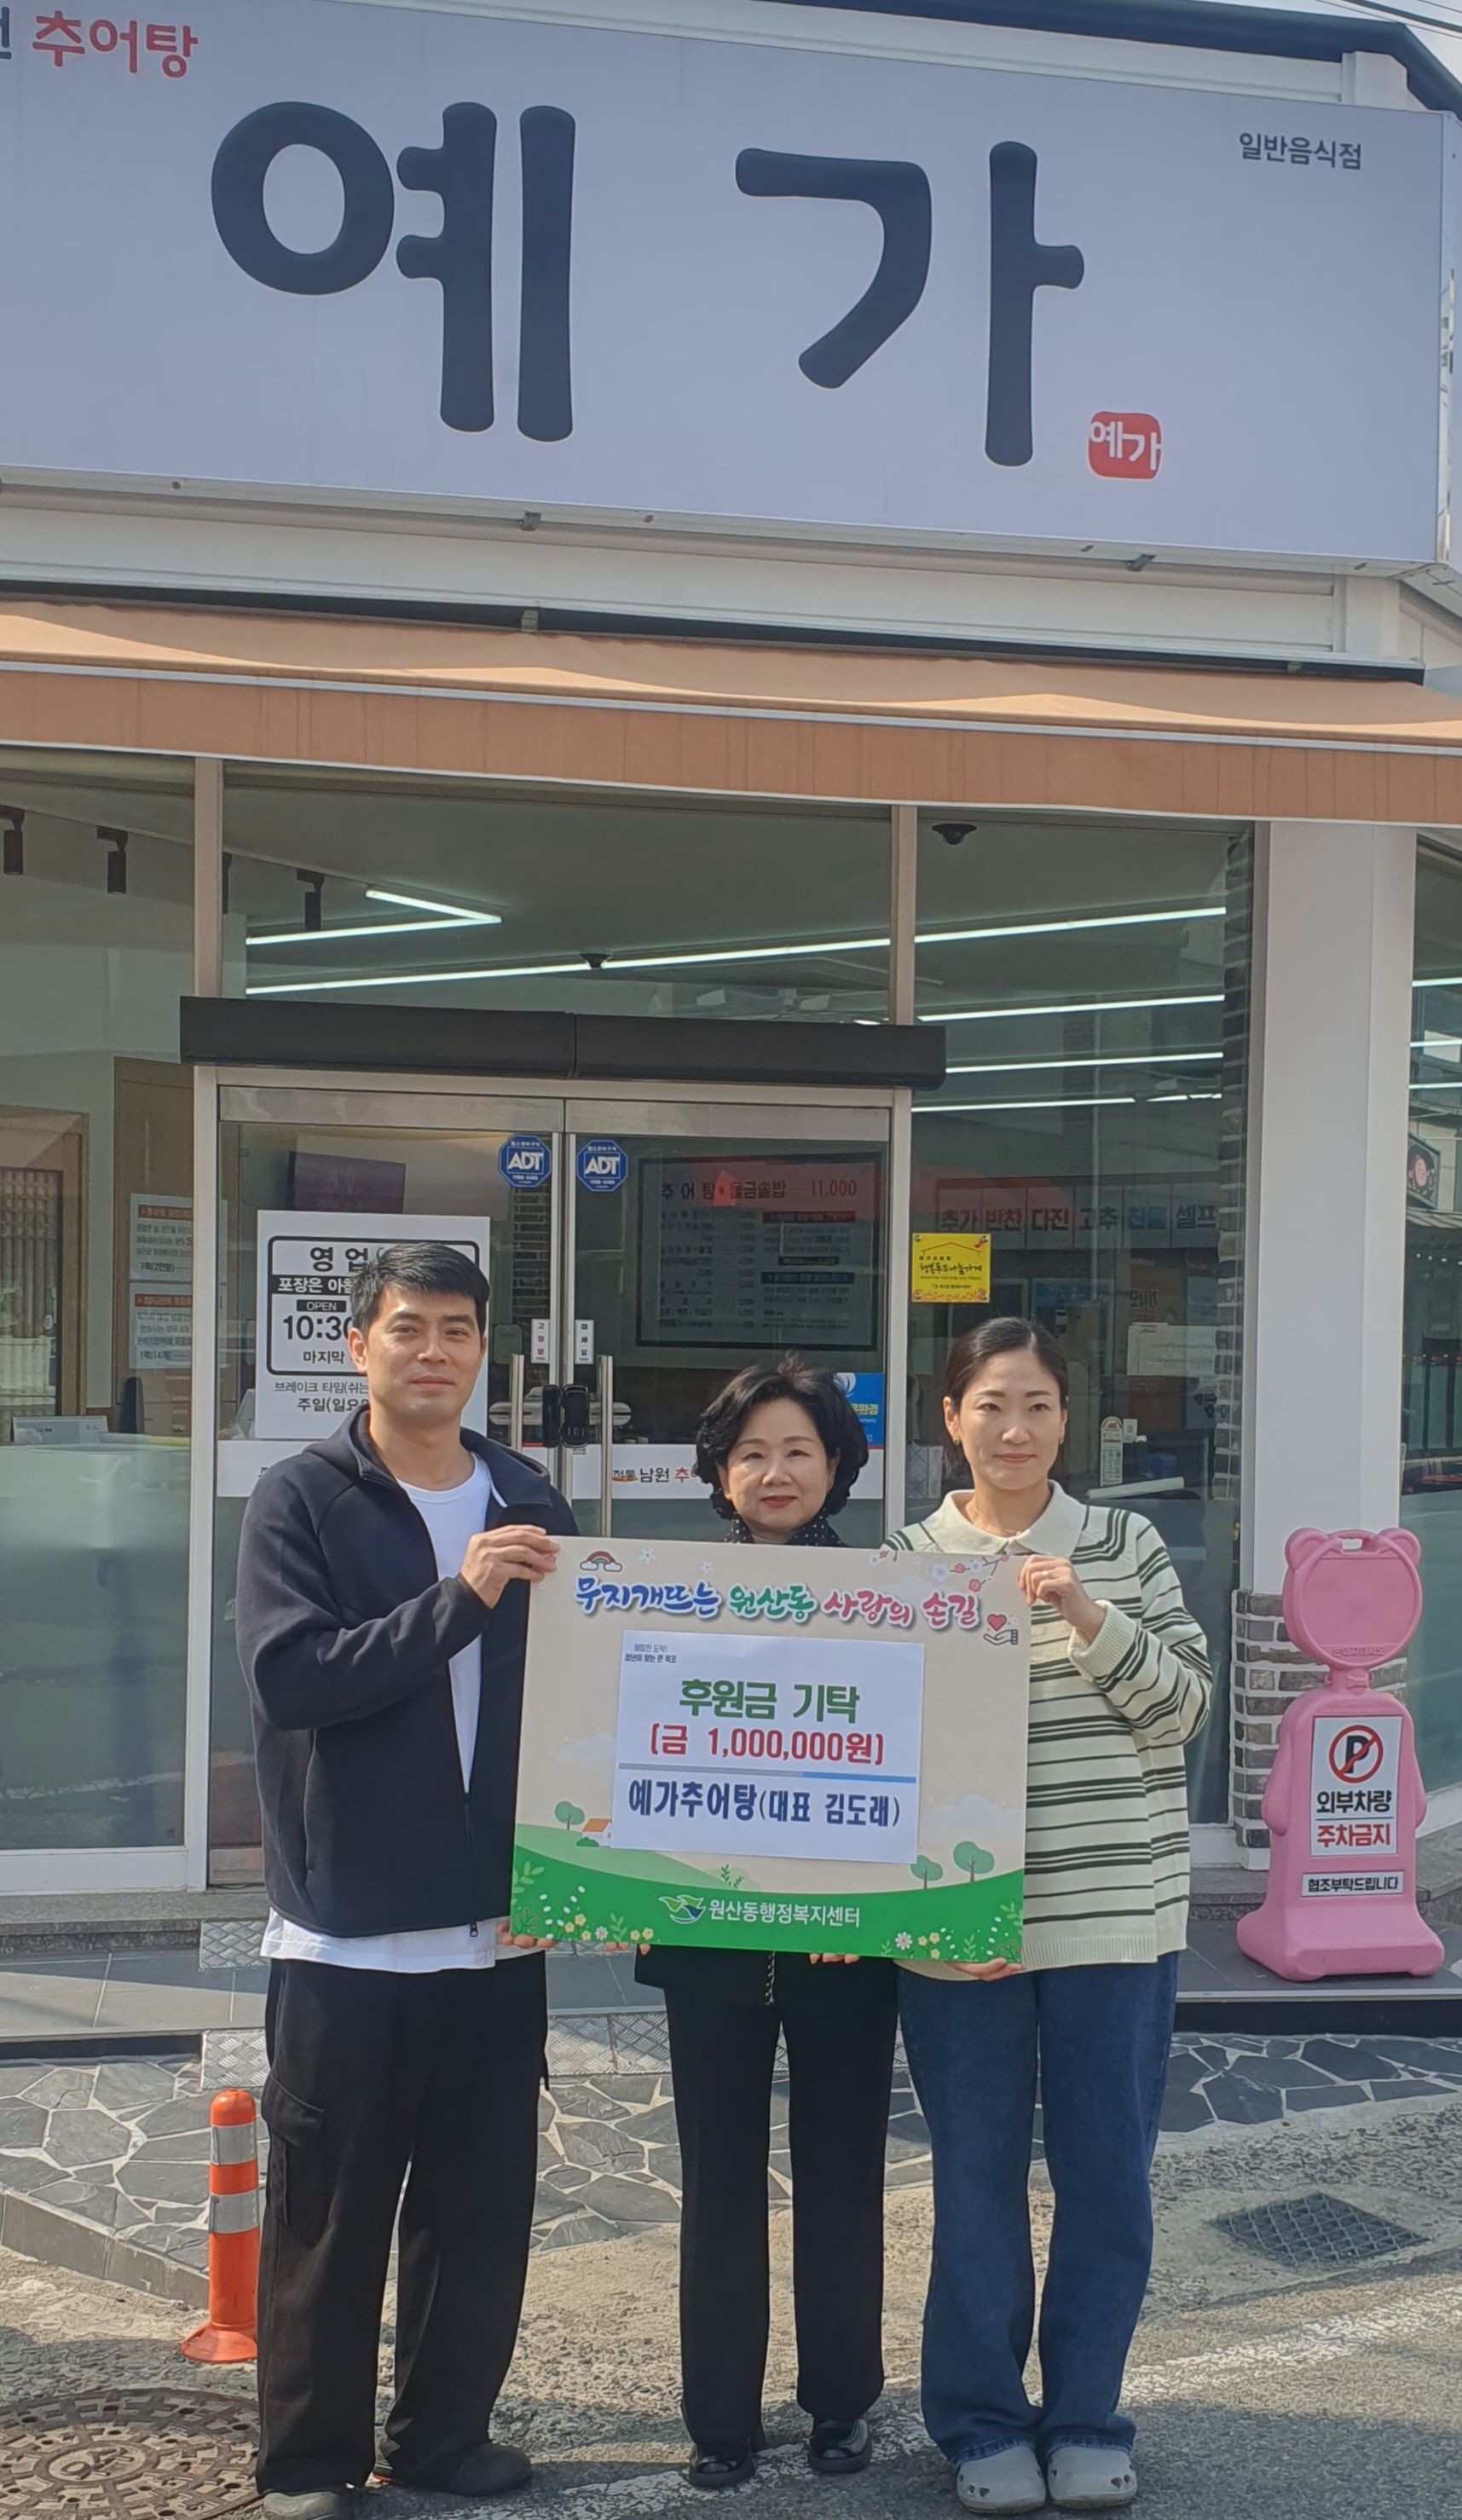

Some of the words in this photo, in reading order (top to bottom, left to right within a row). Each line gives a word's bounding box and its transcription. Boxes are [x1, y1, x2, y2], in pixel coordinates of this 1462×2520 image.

[32, 10, 199, 78] 추어탕
[1239, 132, 1363, 171] 일반음식점
[1089, 420, 1162, 471] 예가
[507, 1152, 544, 1171] ADT
[585, 1156, 621, 1175] ADT
[941, 1207, 979, 1231] 추가
[985, 1206, 1022, 1231] 반찬
[1031, 1206, 1069, 1231] 다진
[1176, 1205, 1216, 1228] 셀프
[277, 1277, 323, 1293] 포장은
[306, 1301, 338, 1312] OPEN
[303, 1350, 345, 1365] 마지막
[274, 1381, 319, 1394] 브레이크
[639, 1467, 670, 1483] 남원
[674, 1467, 697, 1483] 추
[575, 1575, 721, 1618] 무지개뜨는
[728, 1582, 814, 1621] 원산동
[823, 1588, 912, 1626] 사랑의
[922, 1590, 979, 1628] 손길
[679, 1679, 777, 1719] 후원금
[793, 1684, 861, 1724] 기탁
[628, 1777, 812, 1824] 예가추어탕(대표
[825, 1794, 901, 1828] 김도래)
[1316, 1789, 1392, 1815] 외부차량
[1316, 1824, 1391, 1848] 주차금지
[1307, 1876, 1400, 1893] 협조부탁드립니다
[708, 1898, 861, 1928] 원산동행정복지센터
